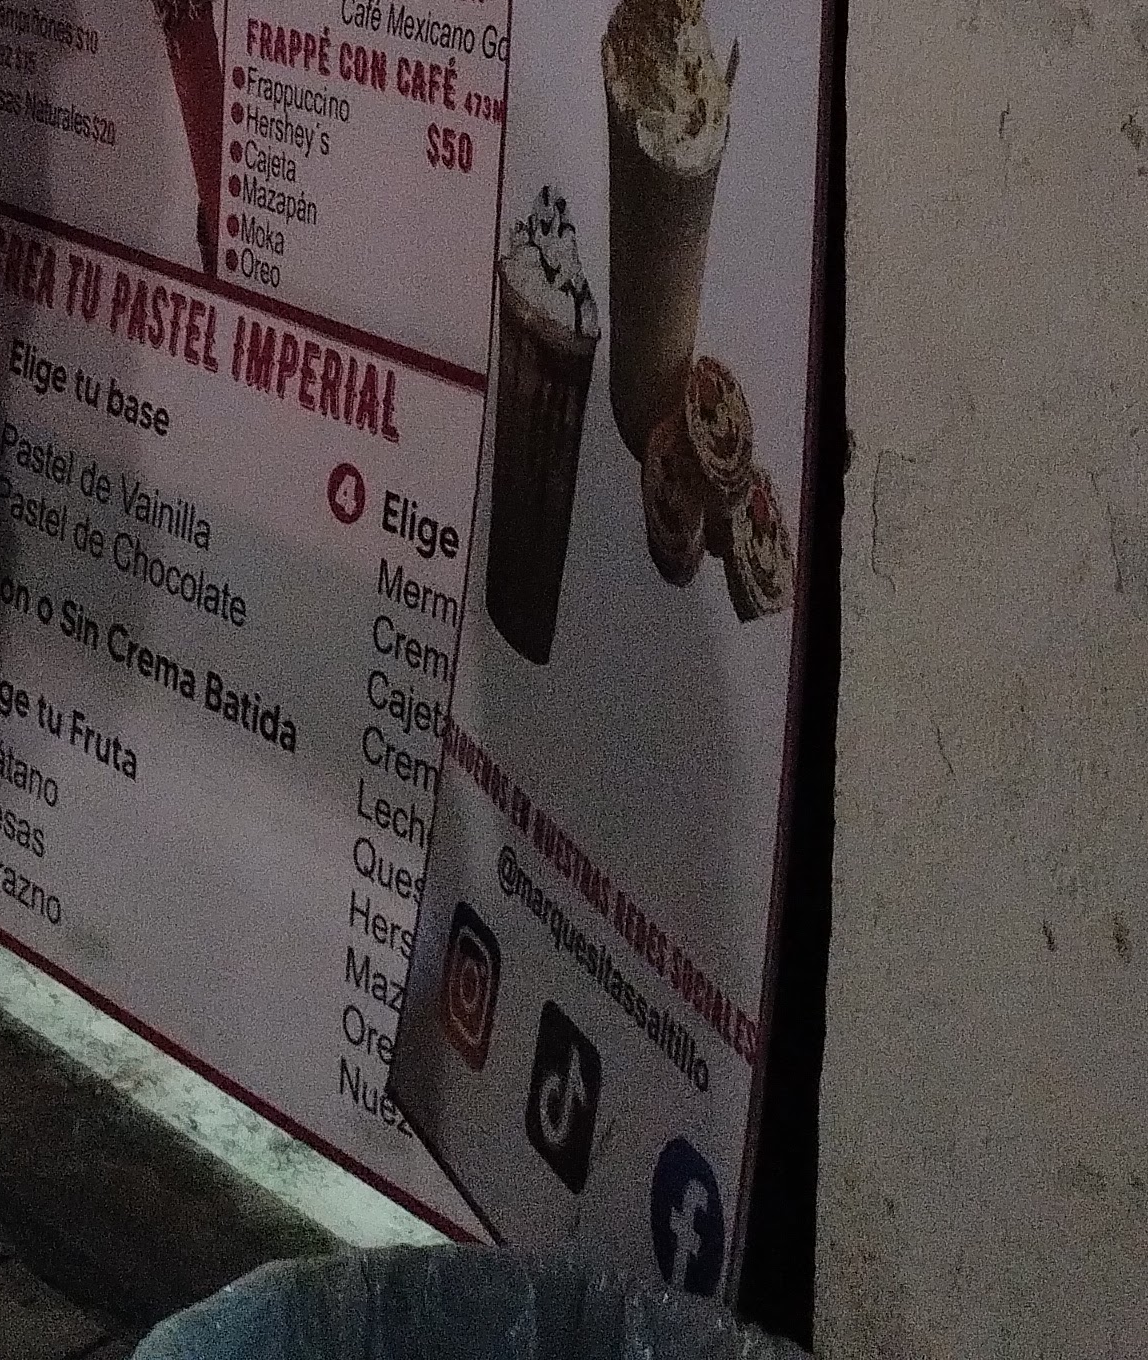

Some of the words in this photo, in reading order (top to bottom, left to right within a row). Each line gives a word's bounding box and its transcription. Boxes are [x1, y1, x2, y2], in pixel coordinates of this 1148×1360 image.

[387, 3, 475, 54] Mexicano
[246, 66, 350, 123] Frappuccino
[247, 17, 331, 77] FRAPPÉ
[339, 41, 386, 93] CON
[396, 56, 458, 111] CAFÉ
[25, 90, 91, 138] Naturales
[427, 122, 473, 174] $50
[244, 140, 297, 182] Cajeta
[240, 211, 285, 256] Moka
[242, 173, 317, 225] Mazapán
[240, 247, 281, 288] Oreo
[65, 252, 101, 323] TU
[110, 271, 219, 374] PASTEL
[231, 316, 400, 444] IMPERIAL
[9, 339, 68, 394] Elige
[75, 368, 100, 407] tu
[107, 378, 171, 437] base
[0, 422, 73, 486] Pastel
[80, 460, 111, 504] de
[121, 474, 212, 551] Vainilla
[382, 490, 459, 559] Elige
[73, 517, 104, 559] de
[113, 531, 246, 627] Chocolate
[37, 596, 53, 625] o
[60, 600, 99, 650] Sin
[108, 624, 195, 702] Crema
[205, 671, 298, 753] Batida
[38, 694, 62, 738] tu
[70, 709, 138, 780] Fruta
[497, 845, 710, 1092] @marquesitassaltillo
